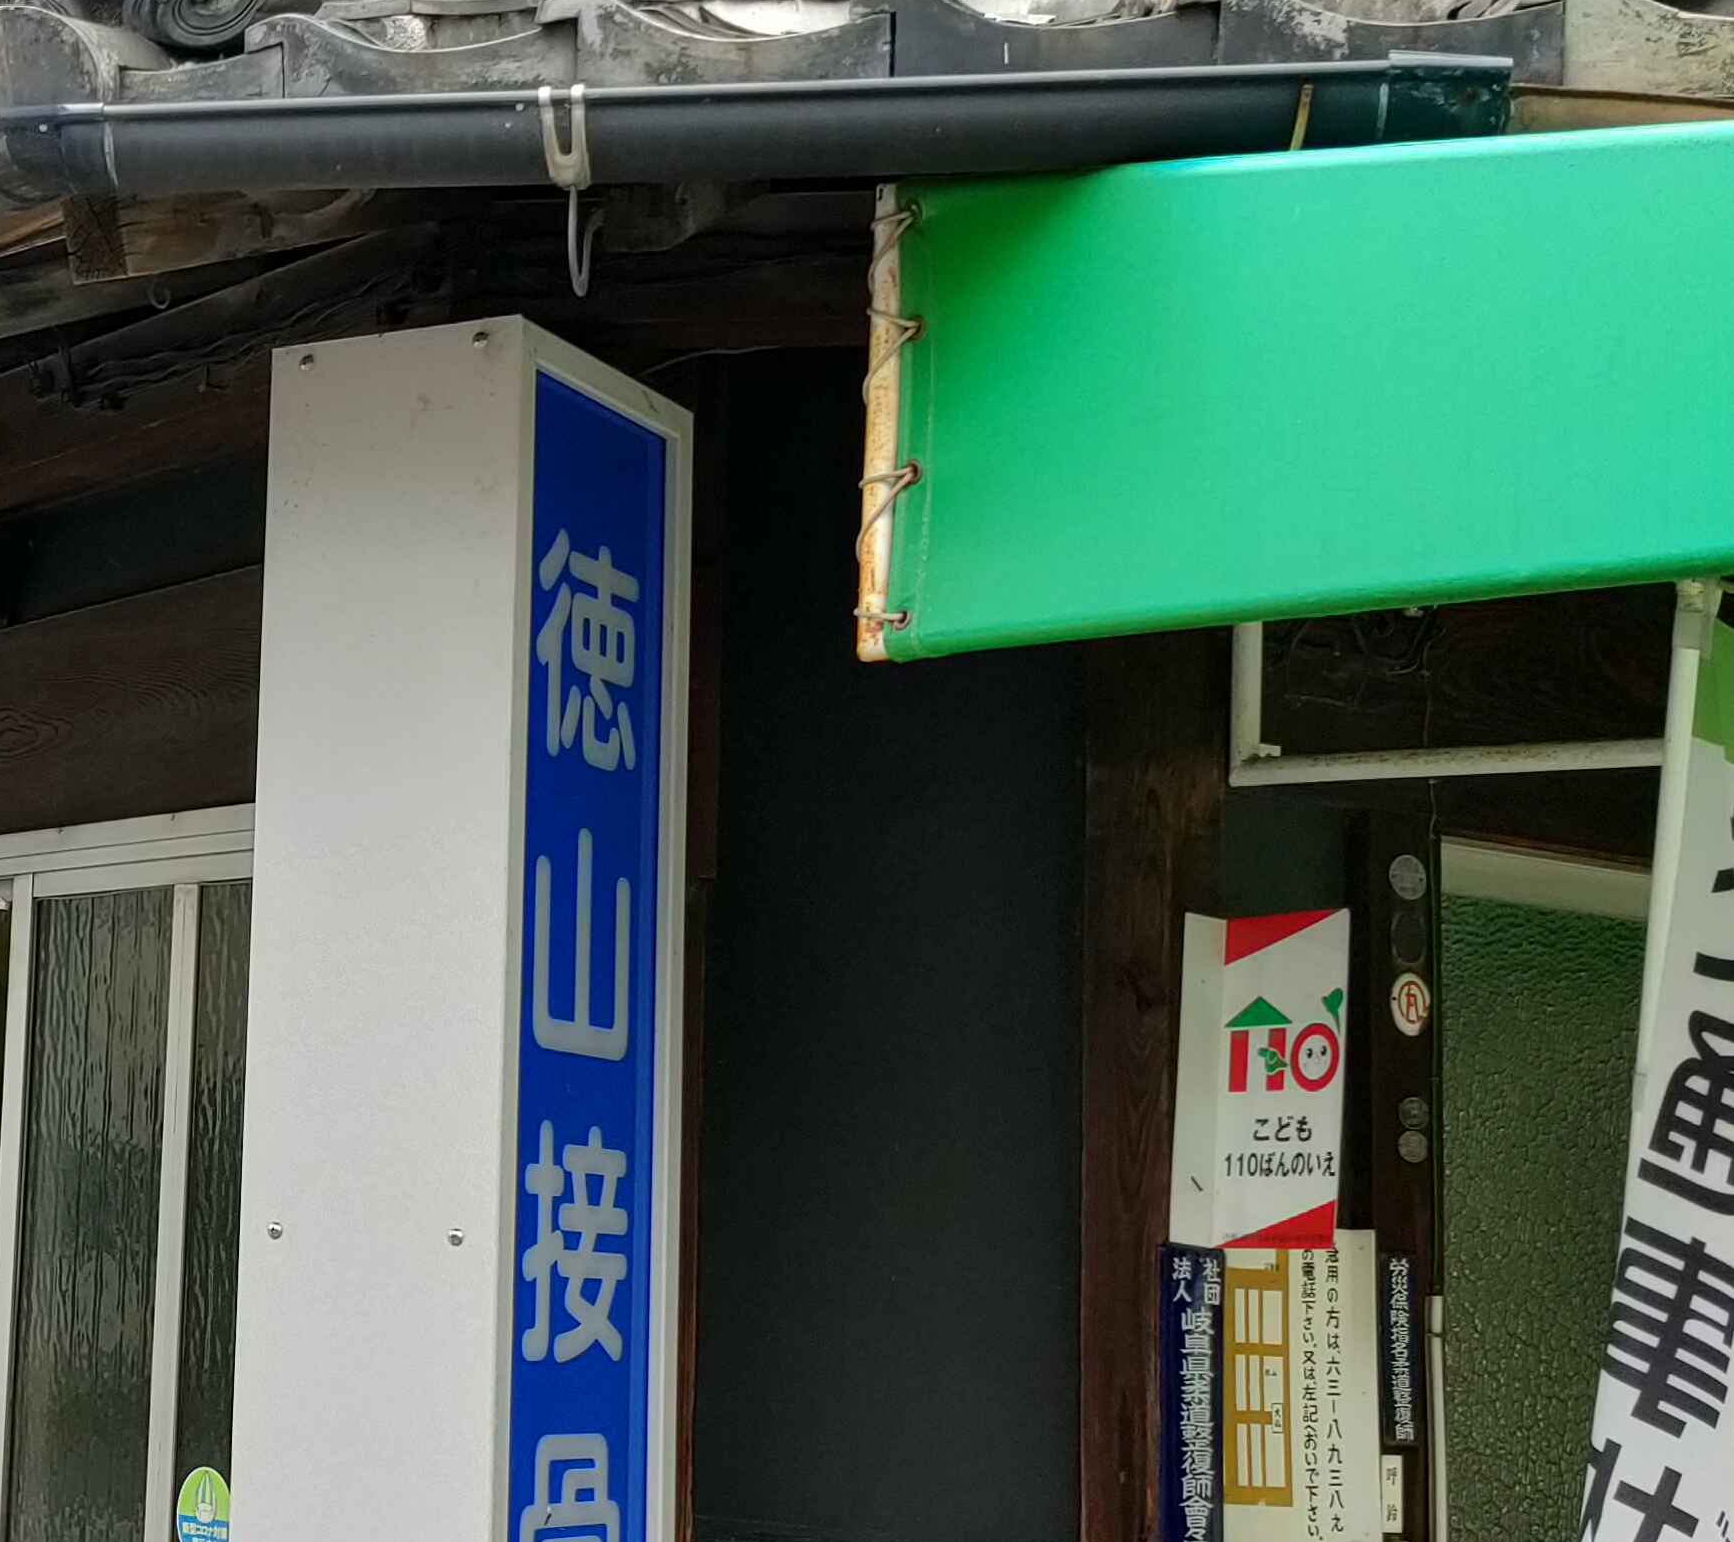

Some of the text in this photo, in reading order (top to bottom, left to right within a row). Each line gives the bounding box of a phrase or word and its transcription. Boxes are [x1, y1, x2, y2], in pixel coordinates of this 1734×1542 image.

[1252, 1115, 1313, 1142] こども
[1224, 1151, 1336, 1177] 110ばんのいえ
[1171, 1257, 1193, 1303] 法人
[1202, 1257, 1222, 1306] 社団
